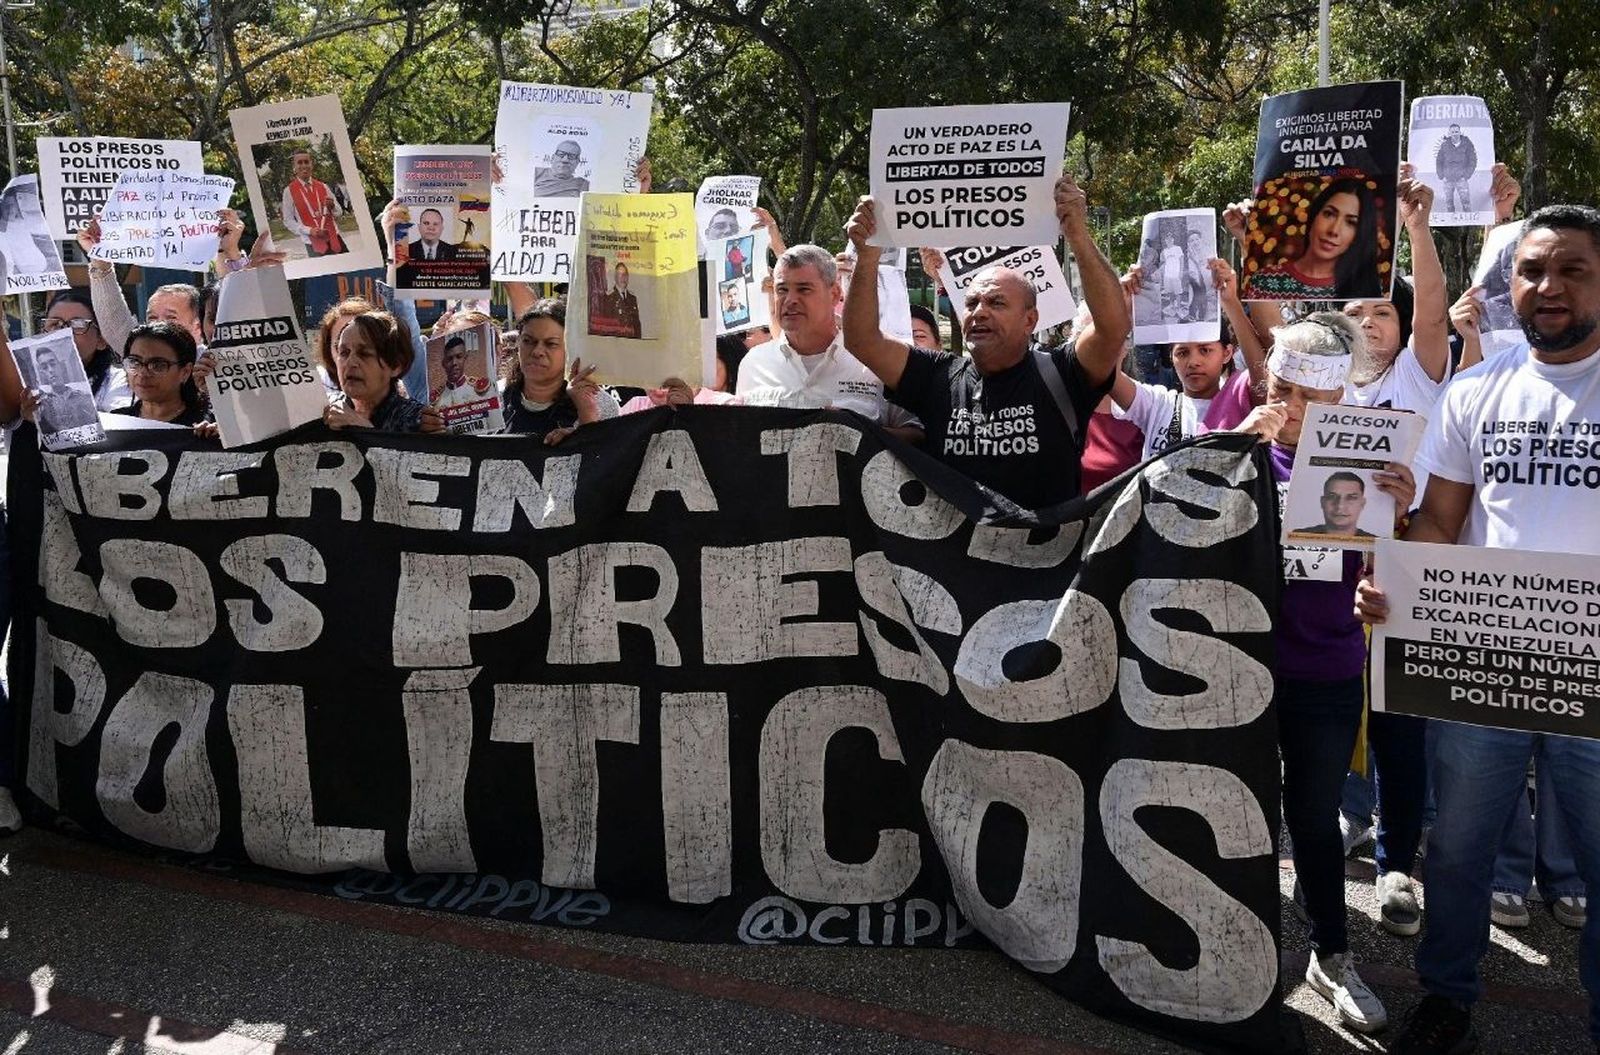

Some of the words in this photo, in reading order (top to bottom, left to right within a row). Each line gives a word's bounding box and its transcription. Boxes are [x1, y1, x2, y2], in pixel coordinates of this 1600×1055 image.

[1275, 113, 1324, 128] EXIGIMOS
[1327, 108, 1383, 121] LIBERTAD
[904, 127, 926, 139] UN
[931, 122, 1032, 138] VERDADERO
[1279, 124, 1338, 137] INMEDIATA
[1341, 120, 1373, 132] PARA
[59, 142, 93, 155] LOS
[97, 143, 165, 156] PRESOS
[888, 143, 930, 157] ACTO
[934, 142, 956, 155] DE
[961, 140, 992, 154] PAZ
[996, 140, 1016, 152] ES
[1021, 139, 1042, 151] LA
[1280, 137, 1337, 154] CARLA
[1341, 134, 1368, 150] DA
[61, 155, 152, 171] POLÍTICOS
[156, 158, 181, 171] NO
[888, 164, 960, 179] LIBERTAD
[964, 162, 985, 176] DE
[989, 160, 1043, 175] TODOS
[1294, 152, 1345, 169] SILVA
[64, 189, 77, 201] A
[117, 190, 140, 203] PAZ
[400, 195, 426, 204] USTO
[703, 197, 754, 208] CARDENAS
[707, 188, 752, 199] JHOLMAR
[895, 188, 935, 205] LOS
[941, 185, 1027, 204] PRESOS
[66, 203, 90, 216] DE
[897, 206, 1025, 230] POLÍTICOS
[520, 235, 557, 248] PARA
[491, 251, 545, 275] ALDO
[949, 246, 1011, 270] TOD
[1003, 248, 1042, 269] ESOS
[954, 274, 977, 290] LO
[216, 320, 289, 341] IBERTAD
[248, 343, 302, 360] TODOS
[213, 364, 243, 379] LOS
[246, 356, 309, 375] PRESOS
[217, 370, 315, 395] POLÍTICOS
[998, 404, 1035, 420] TODOS
[1318, 413, 1400, 430] JACKSON
[947, 420, 971, 436] LOS
[973, 417, 1036, 438] PRESOS
[1482, 421, 1548, 435] LIBEREN
[1552, 422, 1563, 435] A
[944, 435, 1040, 456] POLÍTICOS
[1316, 431, 1392, 453] VERA
[1482, 437, 1522, 457] LOS
[42, 441, 582, 533] IBEREN
[627, 430, 719, 512] A
[1423, 568, 1455, 583] NO
[1462, 571, 1507, 588] HAY
[1513, 573, 1600, 596] NÚMER
[38, 489, 328, 652] LOS
[393, 536, 1275, 730] PRESOS
[1419, 588, 1579, 615] SIGNIFICATIVO
[1412, 606, 1600, 638] EXCARCELACION
[1431, 628, 1457, 643] EN
[1465, 631, 1597, 659] VENEZUELA
[1404, 643, 1461, 662] PERO
[1466, 648, 1485, 666] SÍ
[1492, 653, 1521, 671] UN
[1530, 656, 1600, 680] NÚME
[1404, 662, 1514, 687] DOLOROSO
[1520, 676, 1547, 691] DE
[1450, 685, 1585, 717] POLÍTICOS
[26, 617, 1278, 1024] POLÍTICOS
